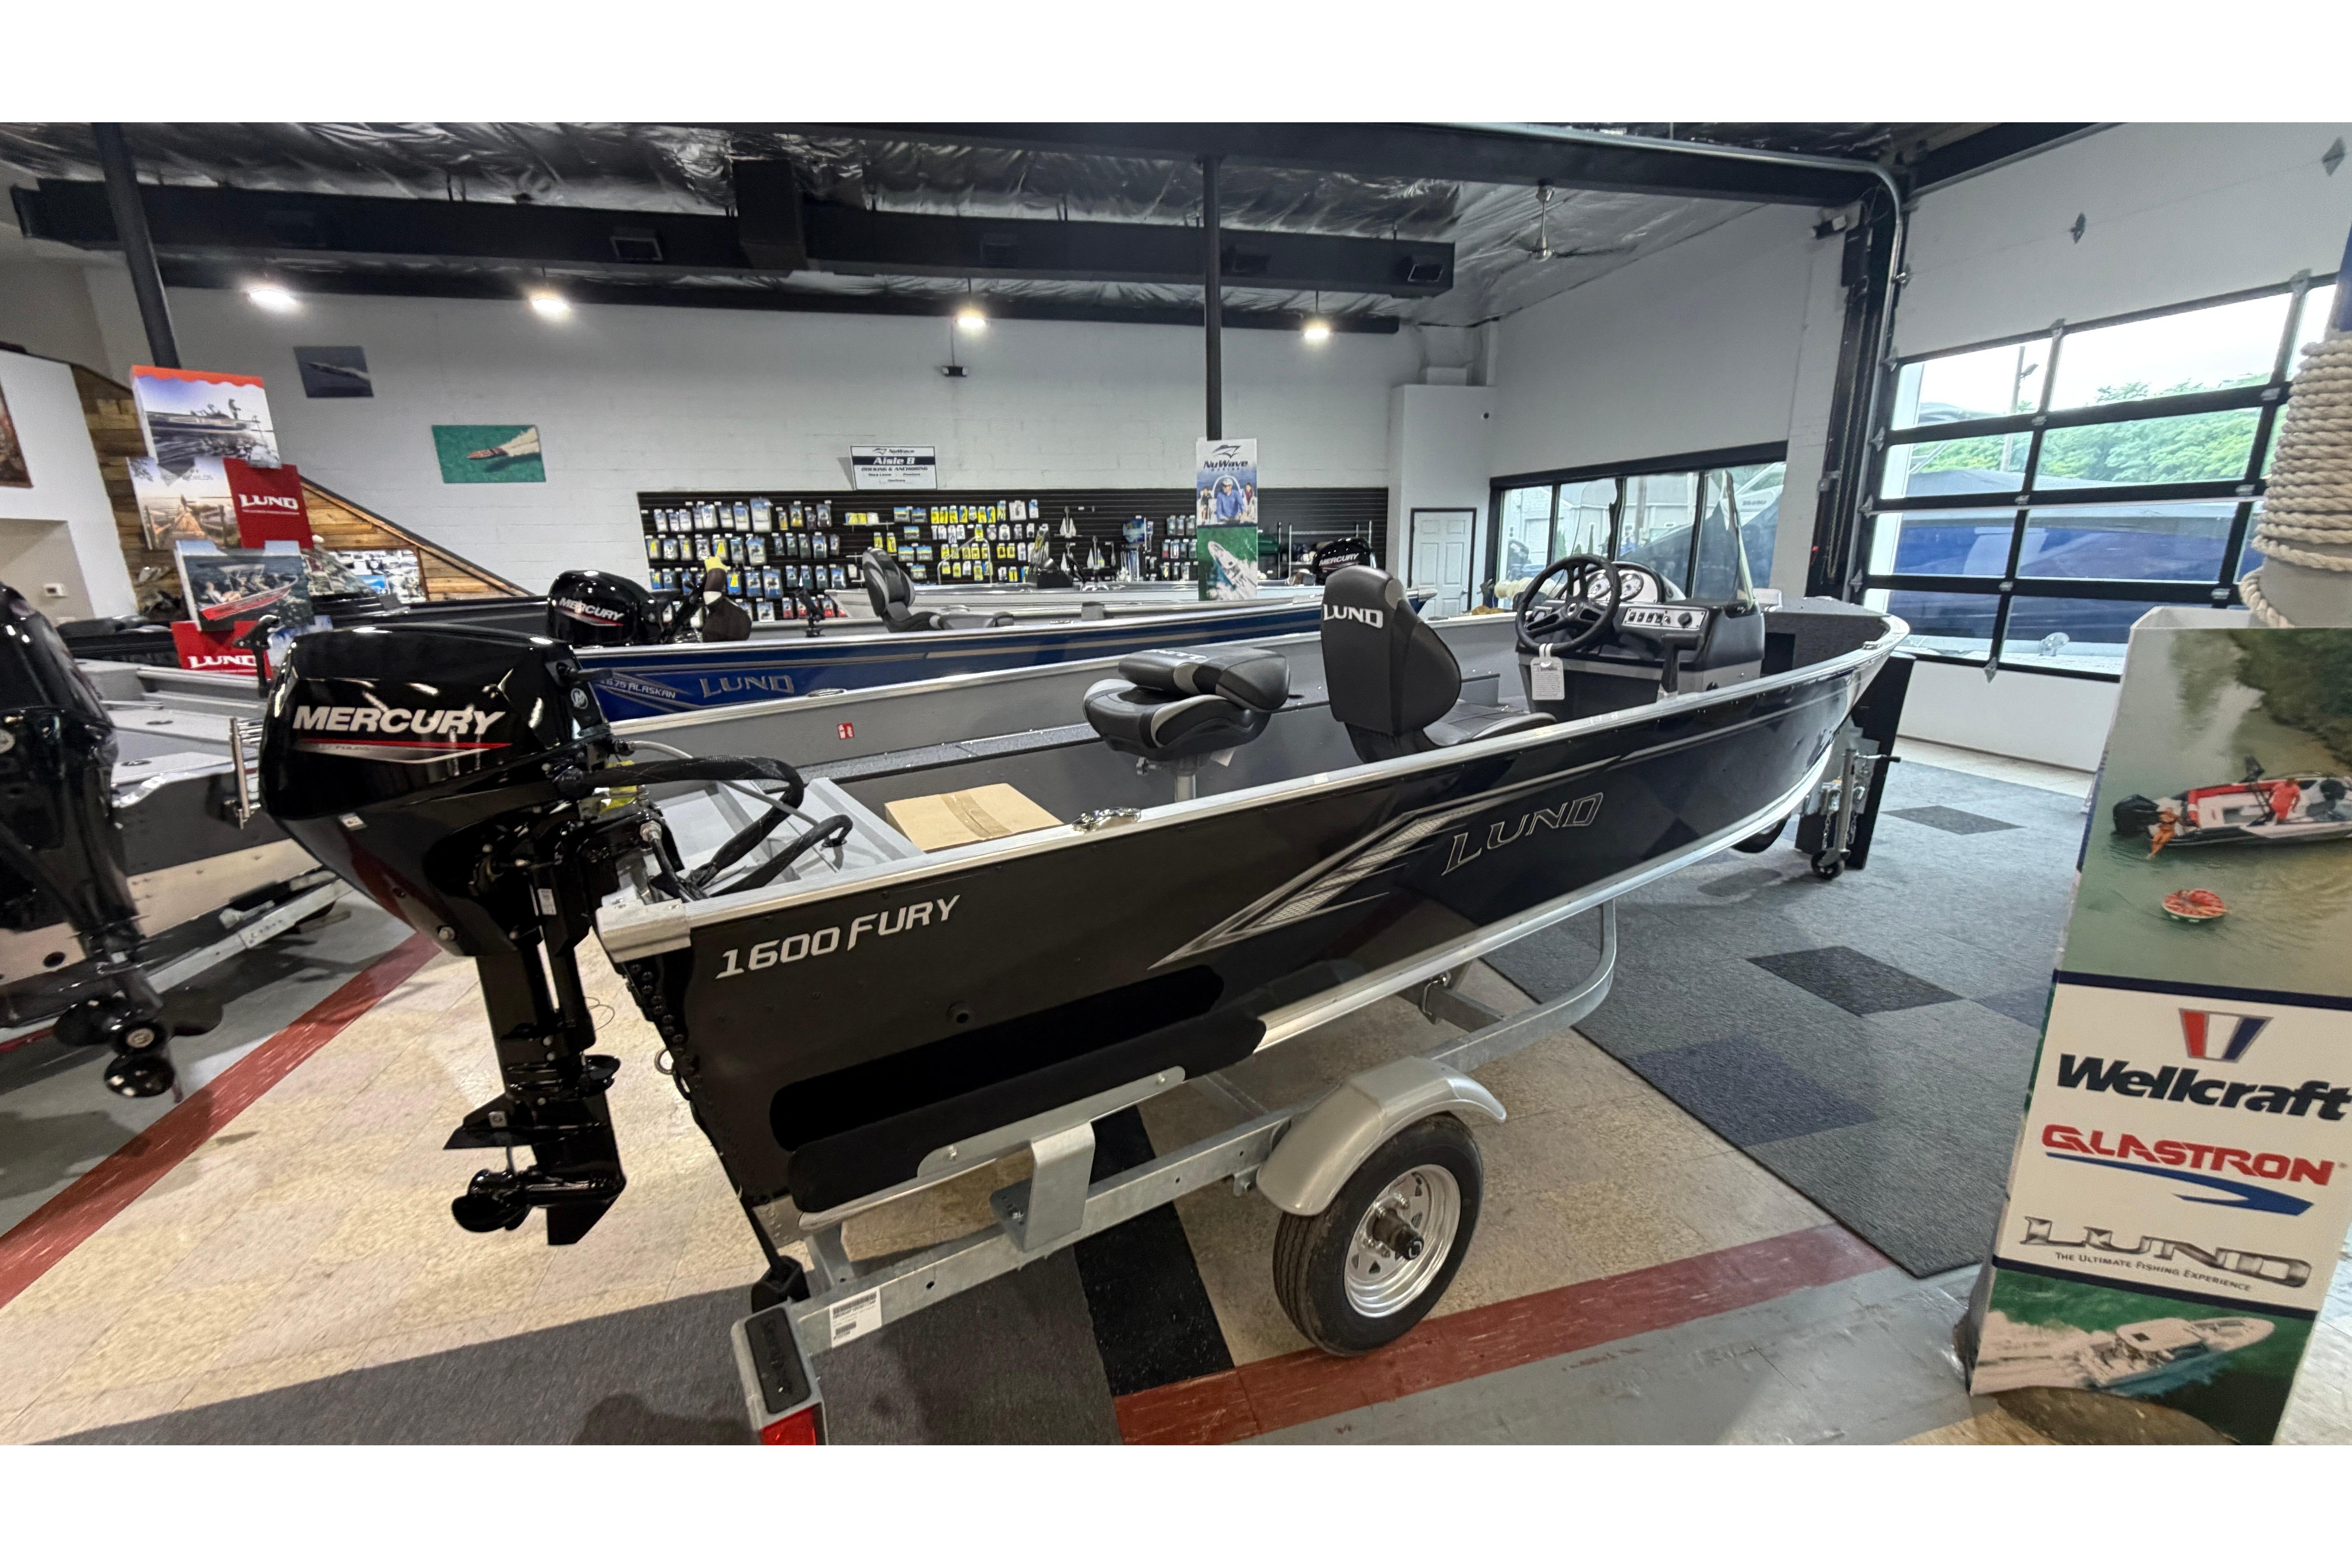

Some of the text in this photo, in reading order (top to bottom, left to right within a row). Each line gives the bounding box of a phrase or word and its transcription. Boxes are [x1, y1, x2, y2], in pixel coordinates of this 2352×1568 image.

[873, 457, 904, 465] Aisle
[1203, 460, 1248, 469] NuWave
[238, 494, 299, 510] LUND
[1318, 553, 1359, 567] MERCURY
[559, 597, 625, 621] MERCURY
[1323, 604, 1384, 629] LUND
[628, 682, 676, 699] ALASKAN
[699, 675, 795, 698] LUND
[292, 705, 505, 734] MERCURY
[1441, 791, 1604, 877] LUND
[715, 894, 961, 980] 1600 FURY
[2057, 1053, 2352, 1121] Wellcraft
[2041, 1123, 2336, 1186] GLASTRON
[2019, 1216, 2312, 1288] LUND
